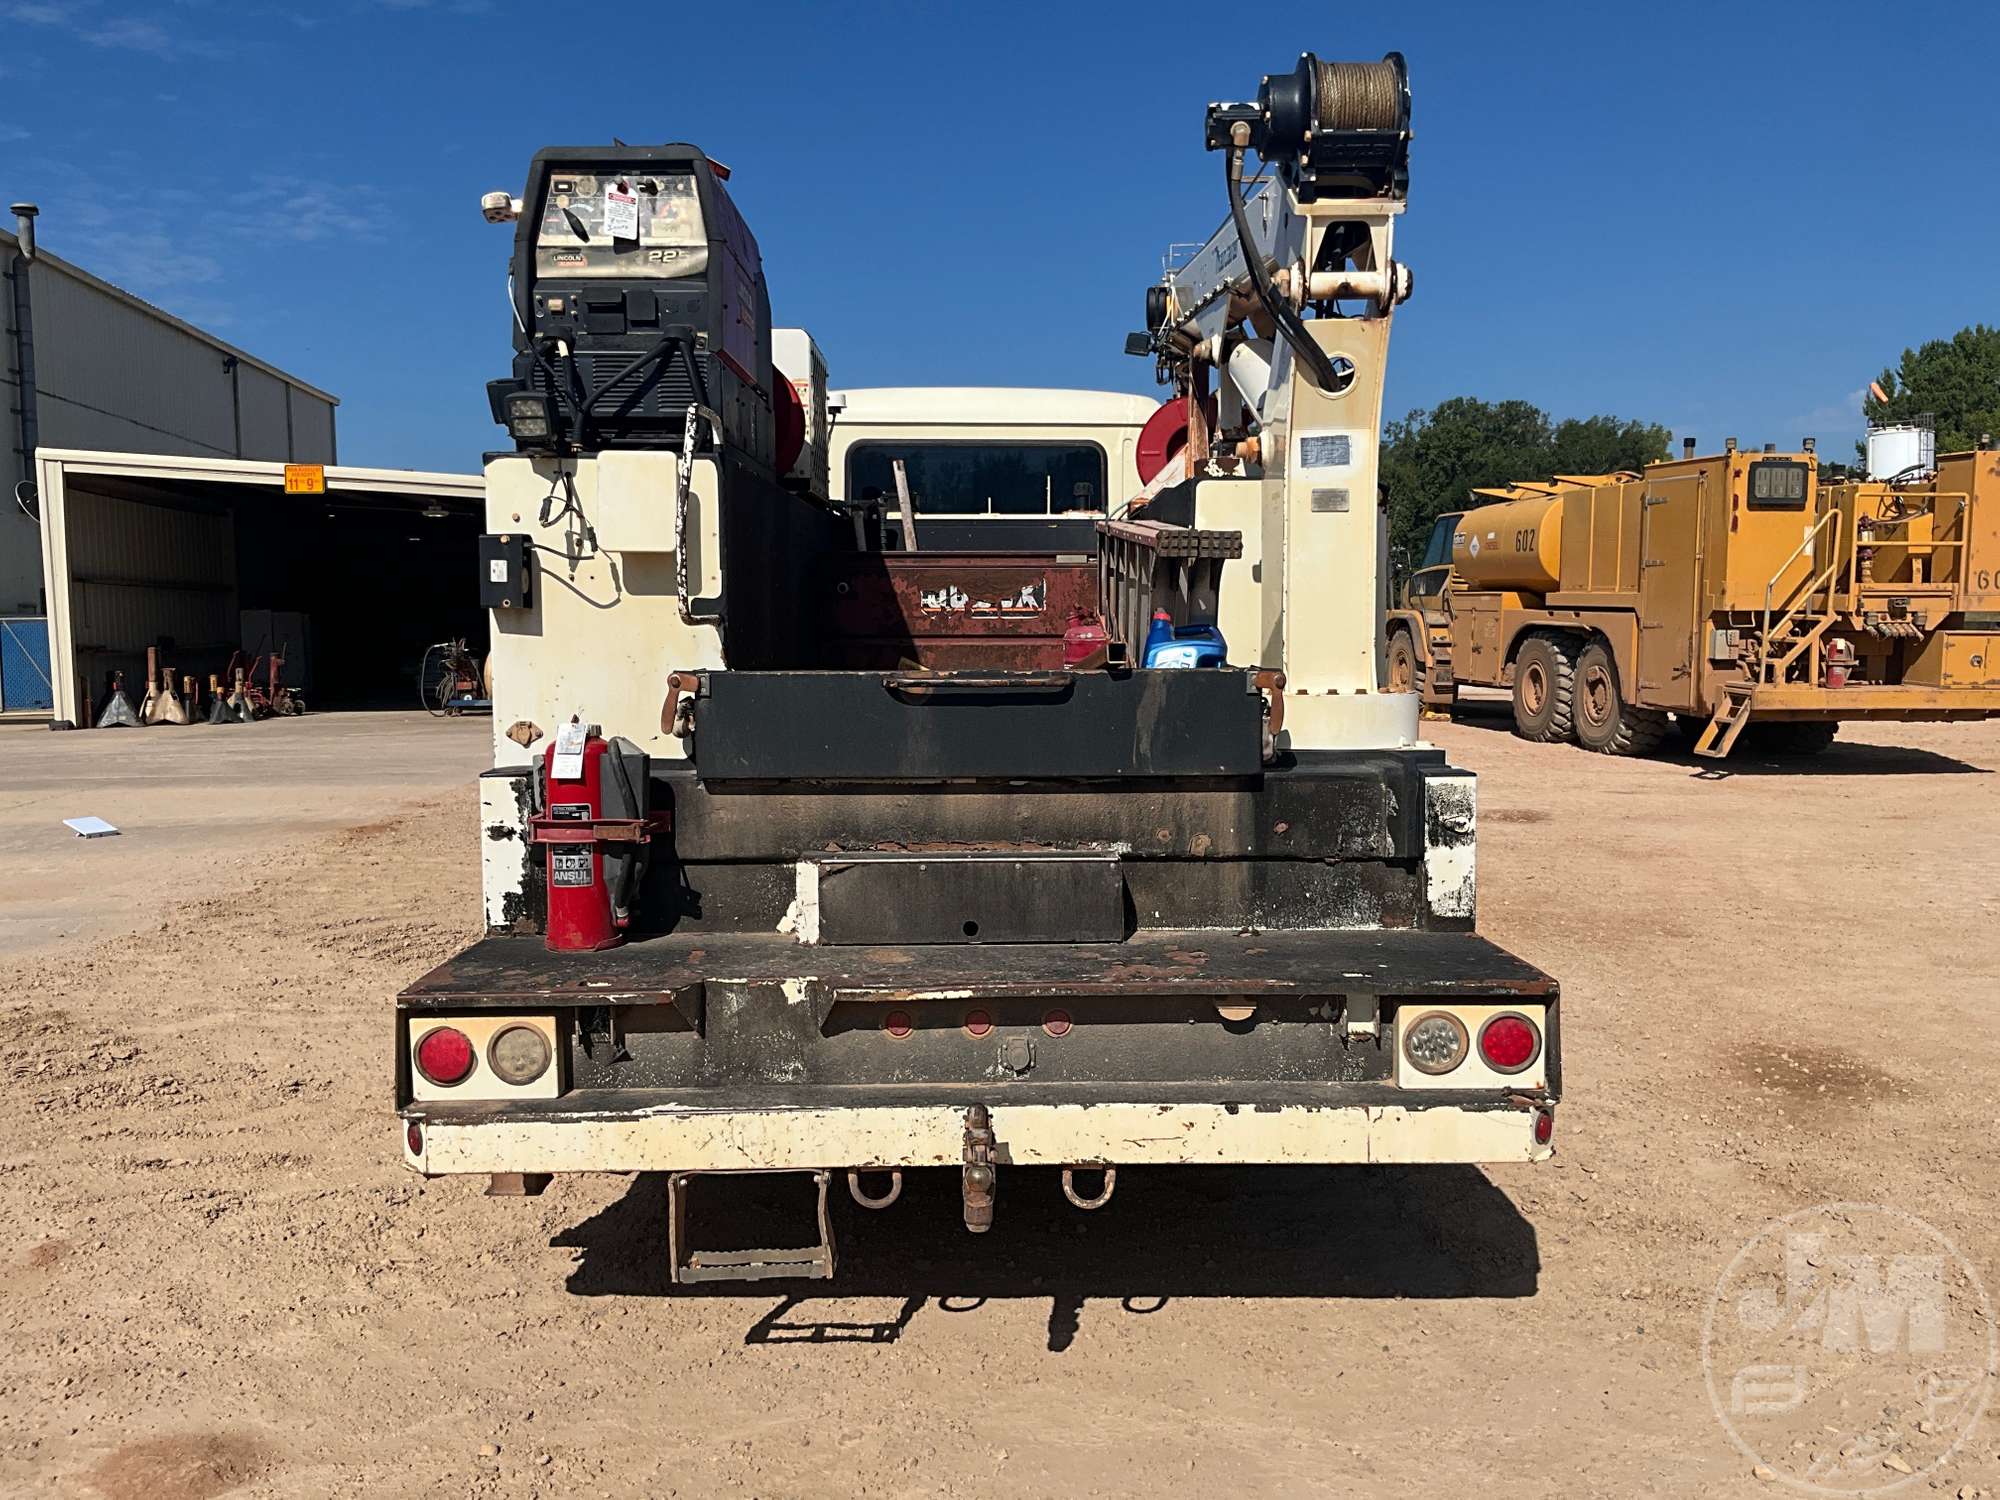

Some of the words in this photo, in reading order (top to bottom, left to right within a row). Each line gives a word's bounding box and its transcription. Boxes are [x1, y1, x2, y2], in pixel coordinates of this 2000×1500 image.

[307, 478, 314, 490] 9
[1515, 528, 1536, 552] 602
[554, 870, 587, 881] ANSUL
